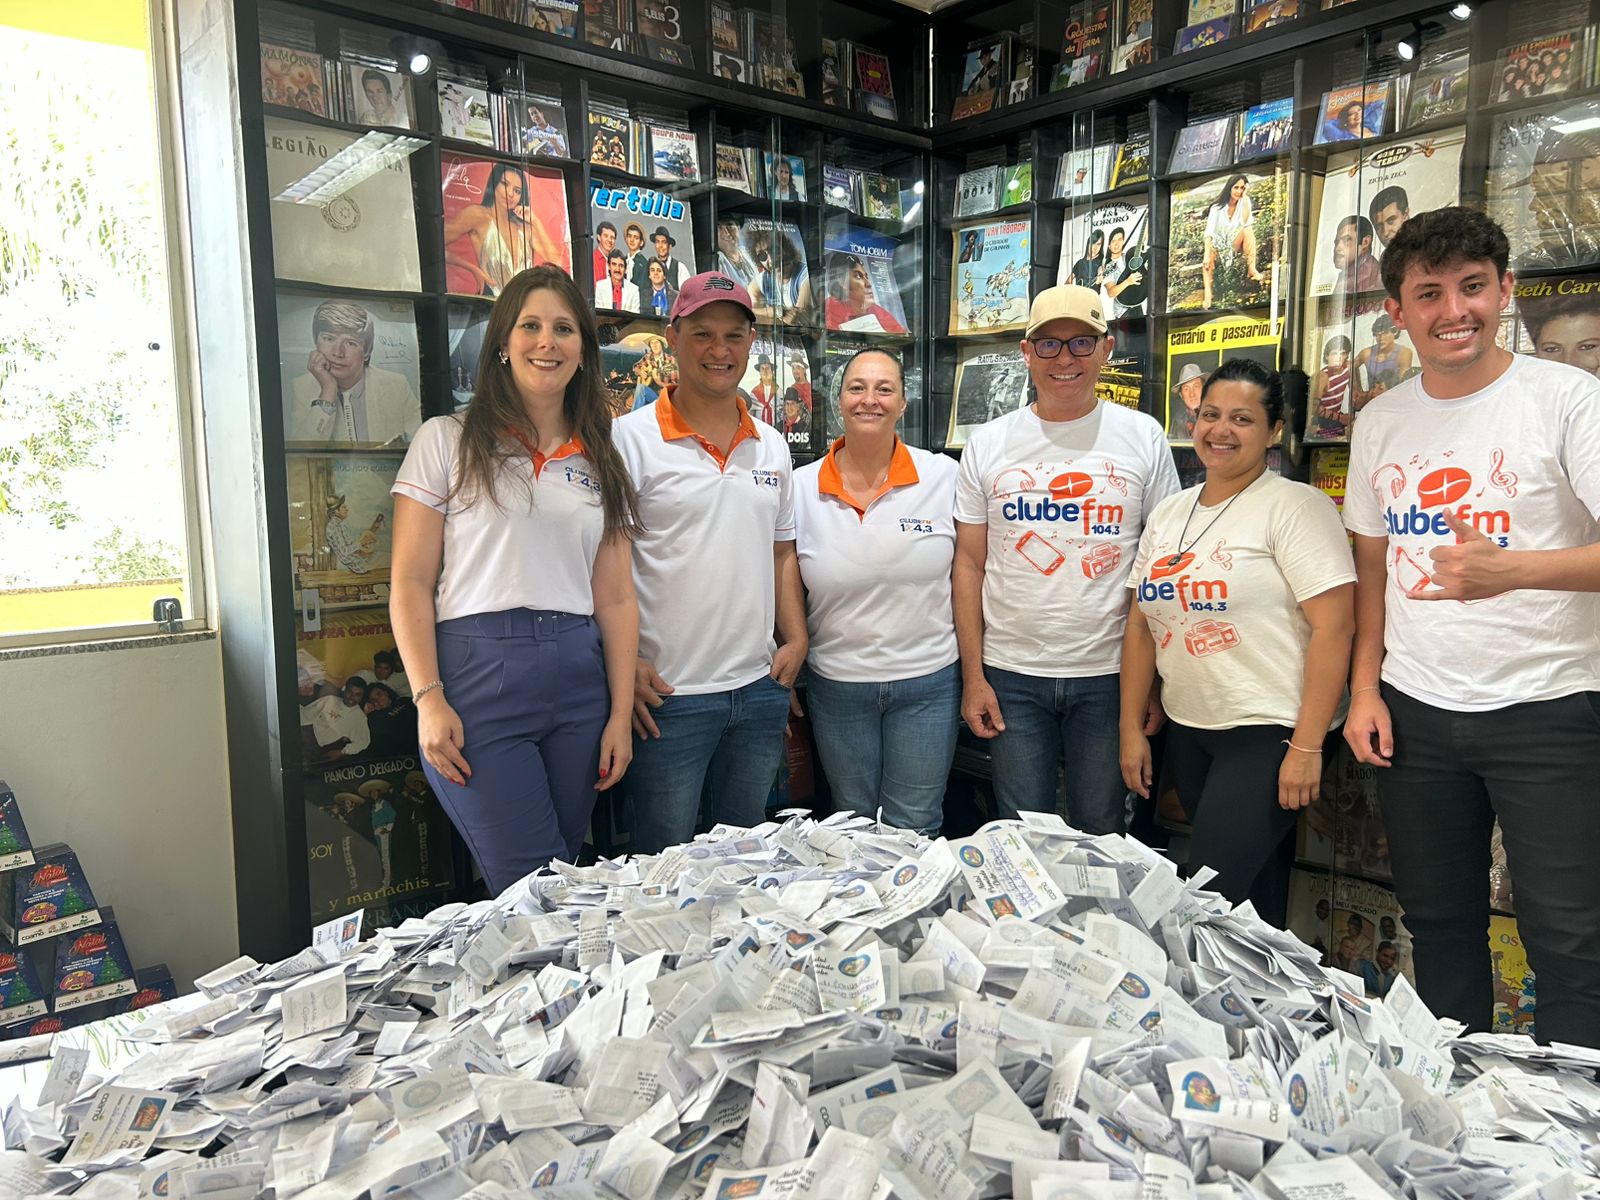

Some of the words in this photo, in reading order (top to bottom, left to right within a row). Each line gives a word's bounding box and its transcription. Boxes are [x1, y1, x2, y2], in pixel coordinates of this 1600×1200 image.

[664, 5, 681, 40] 3
[1065, 22, 1108, 40] ORQUESTRA
[1074, 37, 1101, 57] TERRA
[267, 135, 328, 158] EGIÃO
[1376, 154, 1405, 167] TERRA
[1390, 170, 1408, 180] ZECA
[850, 244, 866, 255] TOM
[867, 246, 888, 257] JOBIM
[1513, 282, 1553, 298] Beth
[1170, 328, 1206, 346] canário
[1210, 328, 1218, 342] e
[1221, 321, 1282, 344] passarino
[787, 432, 810, 443] DOIS
[1091, 525, 1121, 536] 104.3
[1189, 601, 1227, 612] 104.3
[323, 763, 365, 784] PANCHO
[369, 757, 416, 776] DELGADO
[310, 843, 334, 860] SOY
[328, 897, 339, 911] y
[346, 877, 430, 906] mariachis
